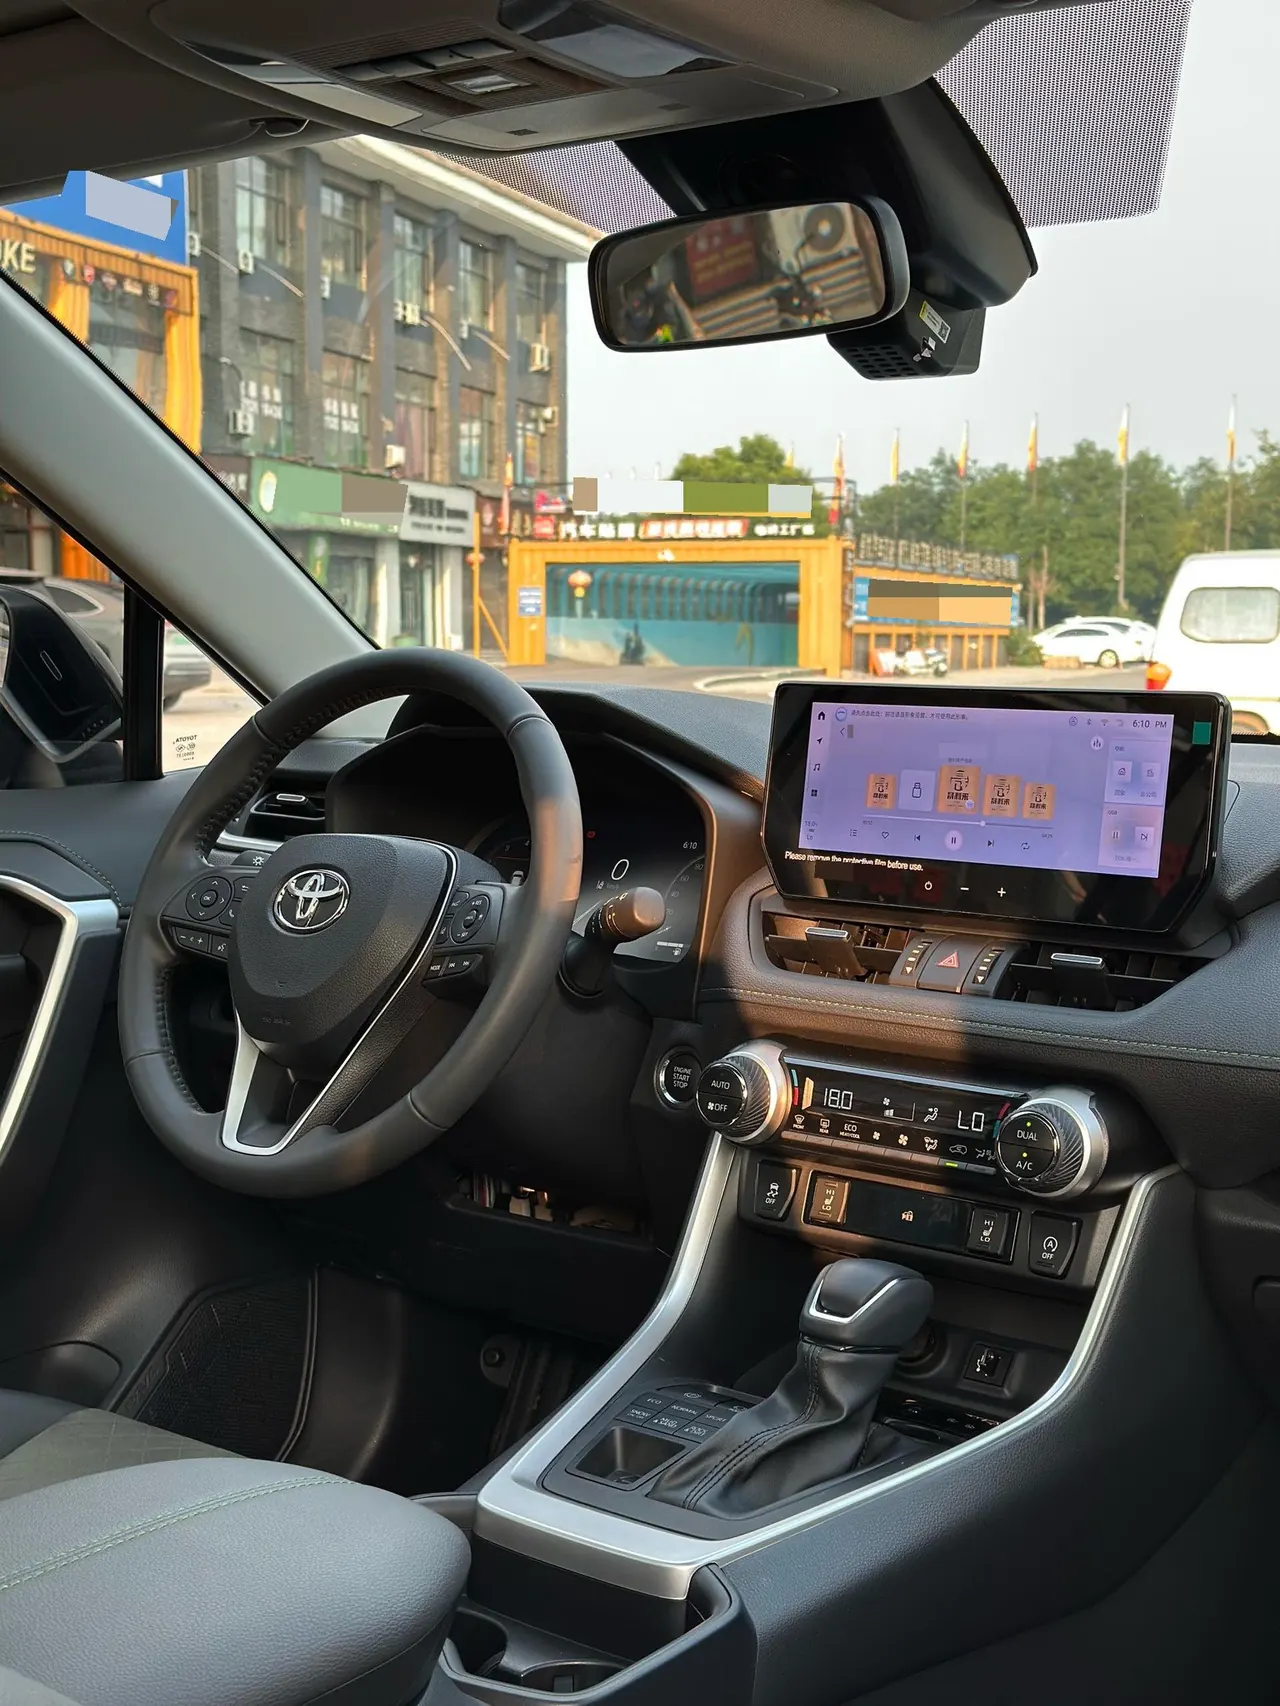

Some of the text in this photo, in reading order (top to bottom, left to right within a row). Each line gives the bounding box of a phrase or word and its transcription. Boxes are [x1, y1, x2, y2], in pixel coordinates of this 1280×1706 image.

[0, 239, 36, 274] KE
[1132, 719, 1168, 728] 6:10 PM
[682, 841, 698, 850] 6:10
[784, 850, 806, 861] Please
[831, 854, 842, 862] the
[874, 858, 886, 866] film
[887, 860, 909, 870] before
[909, 863, 924, 872] use.
[611, 858, 630, 881] 0
[674, 1066, 692, 1075] ENGINE
[672, 1073, 690, 1082] START
[673, 1080, 688, 1089] STOP
[710, 1080, 730, 1090] AUTO
[823, 1088, 854, 1110] 18.0
[714, 1103, 728, 1112] OFF
[957, 1110, 985, 1132] LO
[844, 1123, 858, 1132] ECO
[1016, 1130, 1038, 1142] DUAL
[1016, 1160, 1034, 1171] A/C
[1042, 1252, 1054, 1260] OFF
[671, 1404, 698, 1415] NORMAL
[704, 1414, 728, 1423] SPORT
